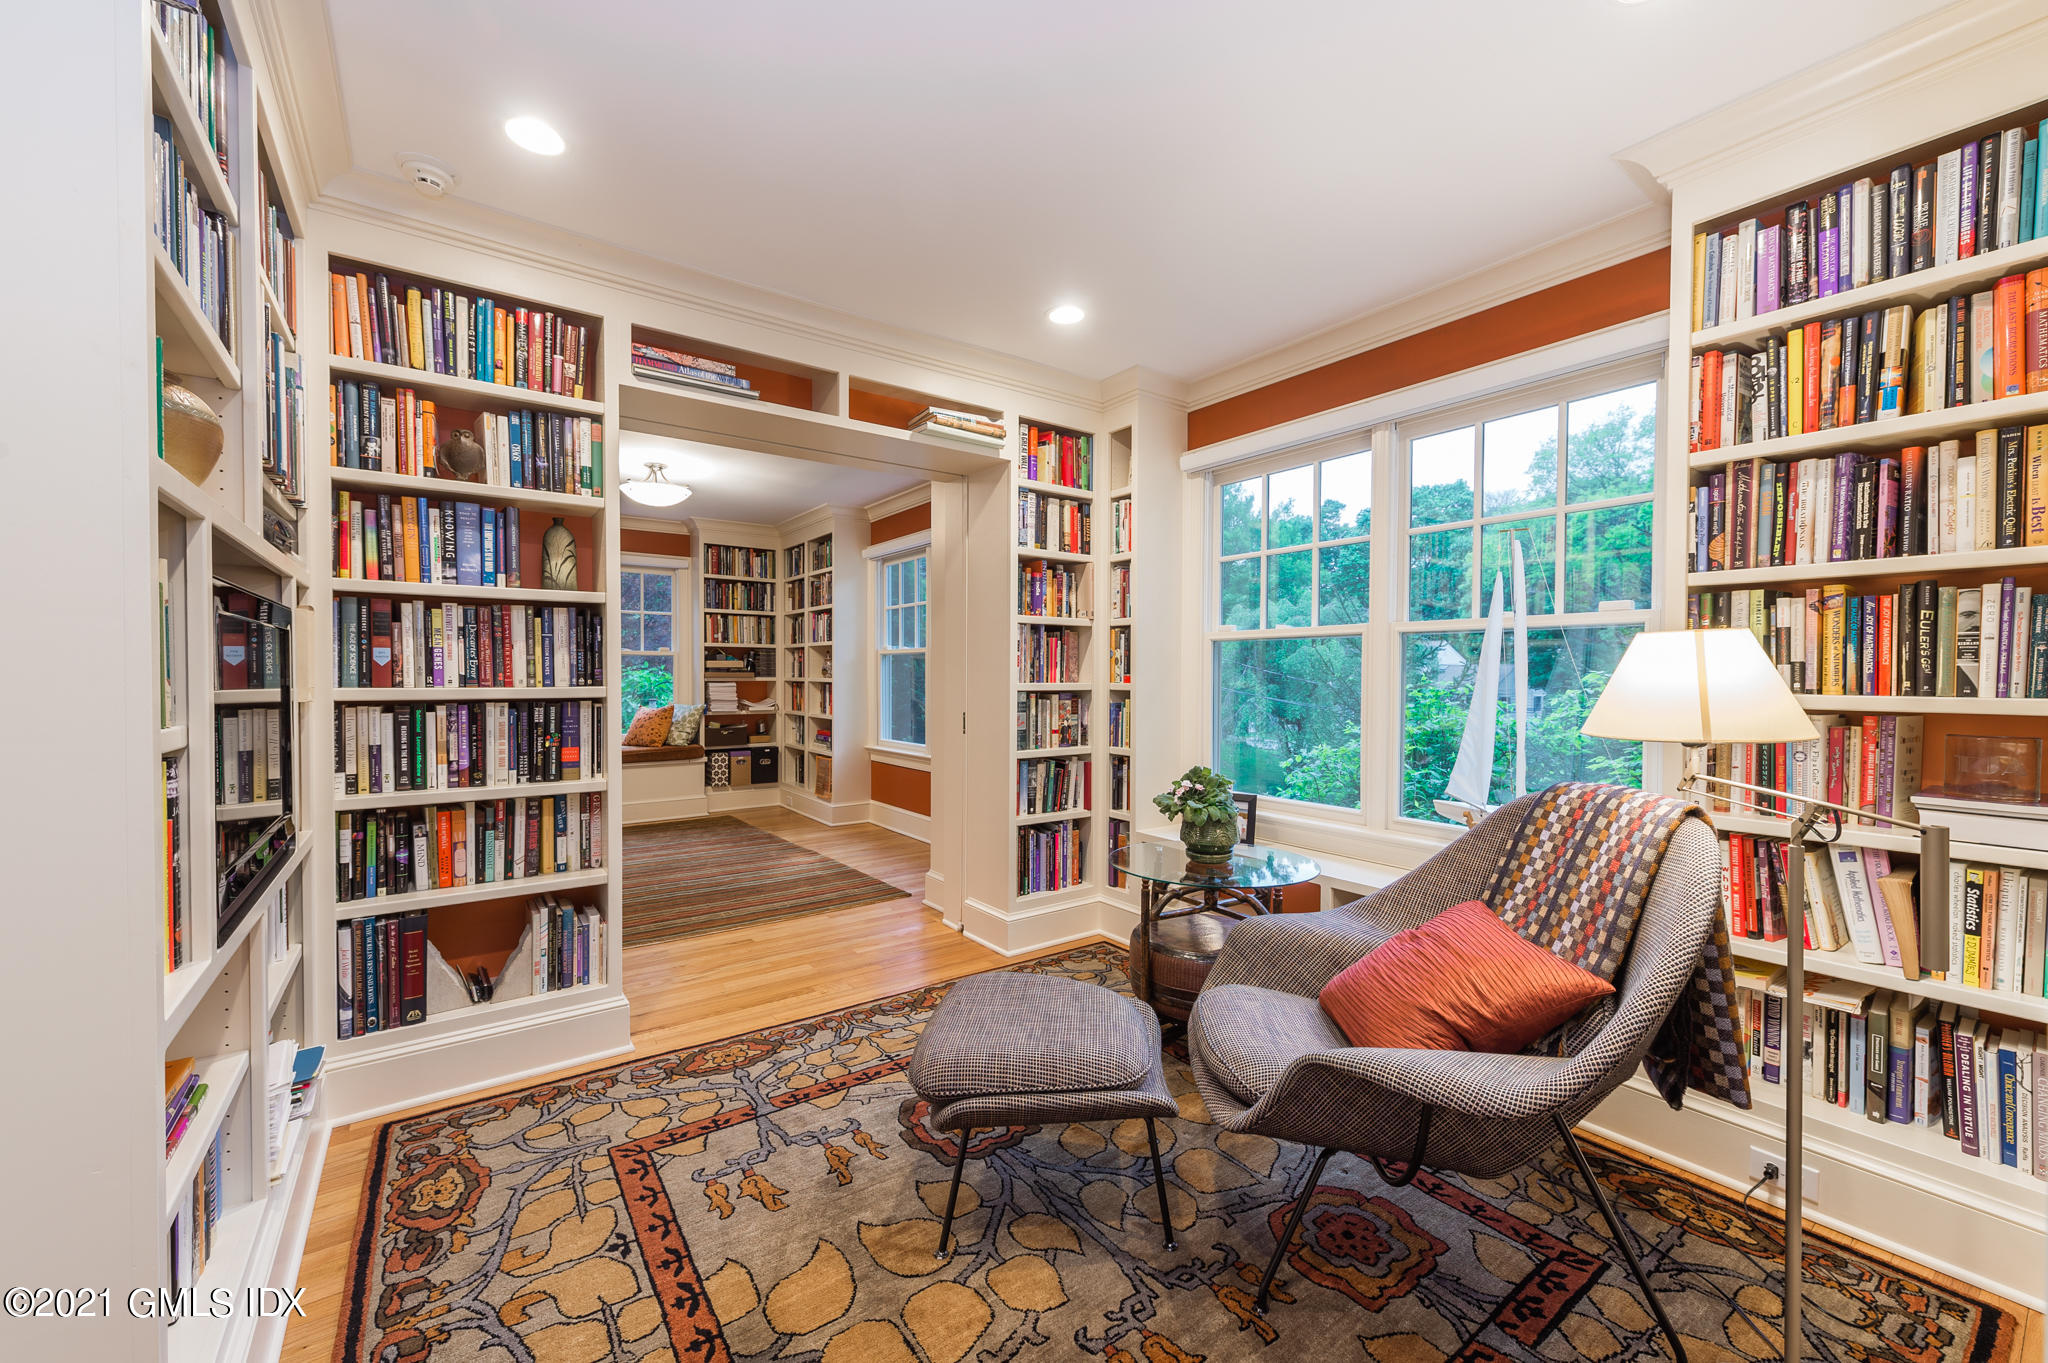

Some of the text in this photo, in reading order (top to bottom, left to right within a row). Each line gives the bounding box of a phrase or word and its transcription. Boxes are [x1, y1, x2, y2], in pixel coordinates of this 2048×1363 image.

[2007, 170, 2016, 194] Problems
[1920, 202, 1929, 227] PRIME
[1960, 164, 1972, 245] LIFE NUMBERS
[1872, 196, 1882, 275] MATHEMATICAL MYSTERIES
[1893, 219, 1905, 242] LOGIC
[1767, 255, 1776, 301] MATHEMATICS
[2008, 290, 2017, 376] THE LAST RECREATIONS
[2038, 311, 2048, 369] MATHEMATICS
[634, 356, 696, 376] HAMMOND Atlas
[1726, 384, 1734, 422] Mathematical
[1904, 460, 1912, 489] GOLDEN
[2032, 455, 2042, 480] When
[1838, 486, 1846, 520] PARSIMONIOUS
[1904, 490, 1912, 512] RATIO
[2004, 441, 2016, 536] Mrs. Perkins's Electric Quilt
[1760, 491, 1772, 516] GAMMA
[407, 503, 417, 540] OXYGEN
[444, 510, 455, 558] KNOWING
[1772, 482, 1784, 558] IMPOSSIBLE?
[1798, 499, 1808, 549] IRRATIONALS
[1944, 508, 1955, 535] Delights
[2032, 506, 2046, 534] Best
[1866, 601, 1875, 613] More
[1986, 599, 1995, 622] ZERO
[1832, 610, 1840, 645] WONDERS
[1867, 624, 1874, 633] OF
[1884, 618, 1890, 626] OF
[1920, 610, 1934, 656] EULER'S
[434, 648, 442, 670] GENES
[469, 624, 478, 678] Descartes' Error
[1832, 653, 1840, 687] NUMBERS
[1921, 658, 1932, 674] GEM
[347, 714, 356, 734] How
[347, 750, 356, 765] Die
[1812, 750, 1820, 762] Flip
[1812, 768, 1820, 785] Coin?
[1845, 870, 1866, 922] Applied Mathematics
[1953, 872, 1961, 893] charles
[2000, 870, 2014, 914] Ubiquity
[1966, 887, 1980, 931] Statistics
[340, 948, 350, 978] Joel White
[1952, 942, 1960, 966] statistics
[1966, 942, 1976, 976] DUMMIES
[1752, 1000, 1760, 1030] inevitable
[1768, 1019, 1780, 1048] WINNING
[1896, 1060, 1905, 1080] Strategies
[1943, 1052, 1954, 1076] DILEMMA
[1961, 1053, 1974, 1138] DEALING IN VIRTUE
[2003, 1074, 2015, 1144] Choice and Consequence
[2038, 1078, 2048, 1129] CHANGING
[2038, 1131, 2048, 1160] MINDS
